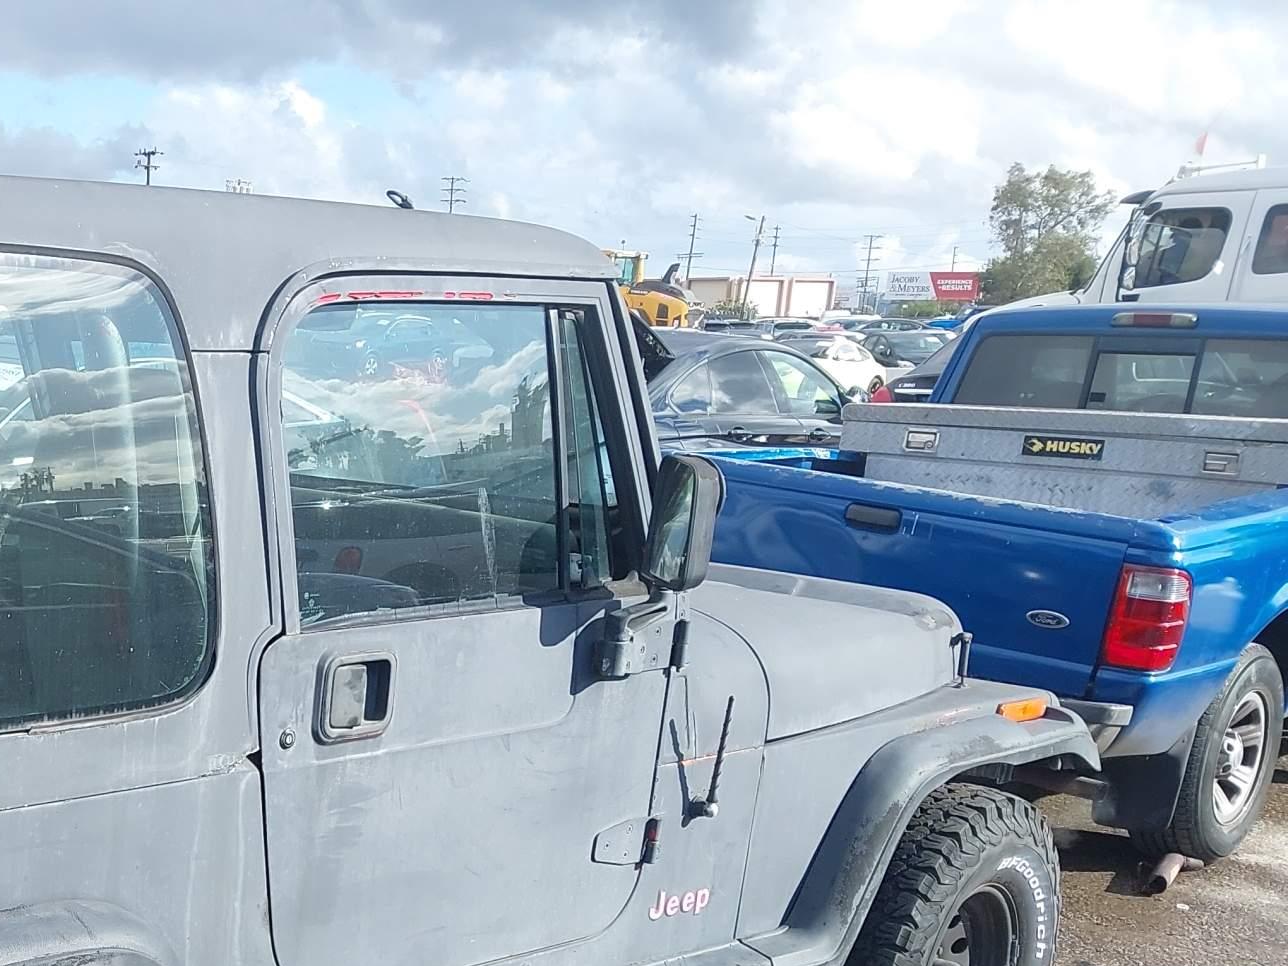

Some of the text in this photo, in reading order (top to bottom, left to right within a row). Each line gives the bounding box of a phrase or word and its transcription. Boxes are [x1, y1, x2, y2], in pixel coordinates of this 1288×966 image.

[892, 274, 920, 283] JACOBY
[896, 284, 930, 293] MEYERS
[1045, 440, 1103, 455] HUSKY
[648, 888, 710, 920] Jeep
[996, 856, 1048, 959] BFGoodrich
